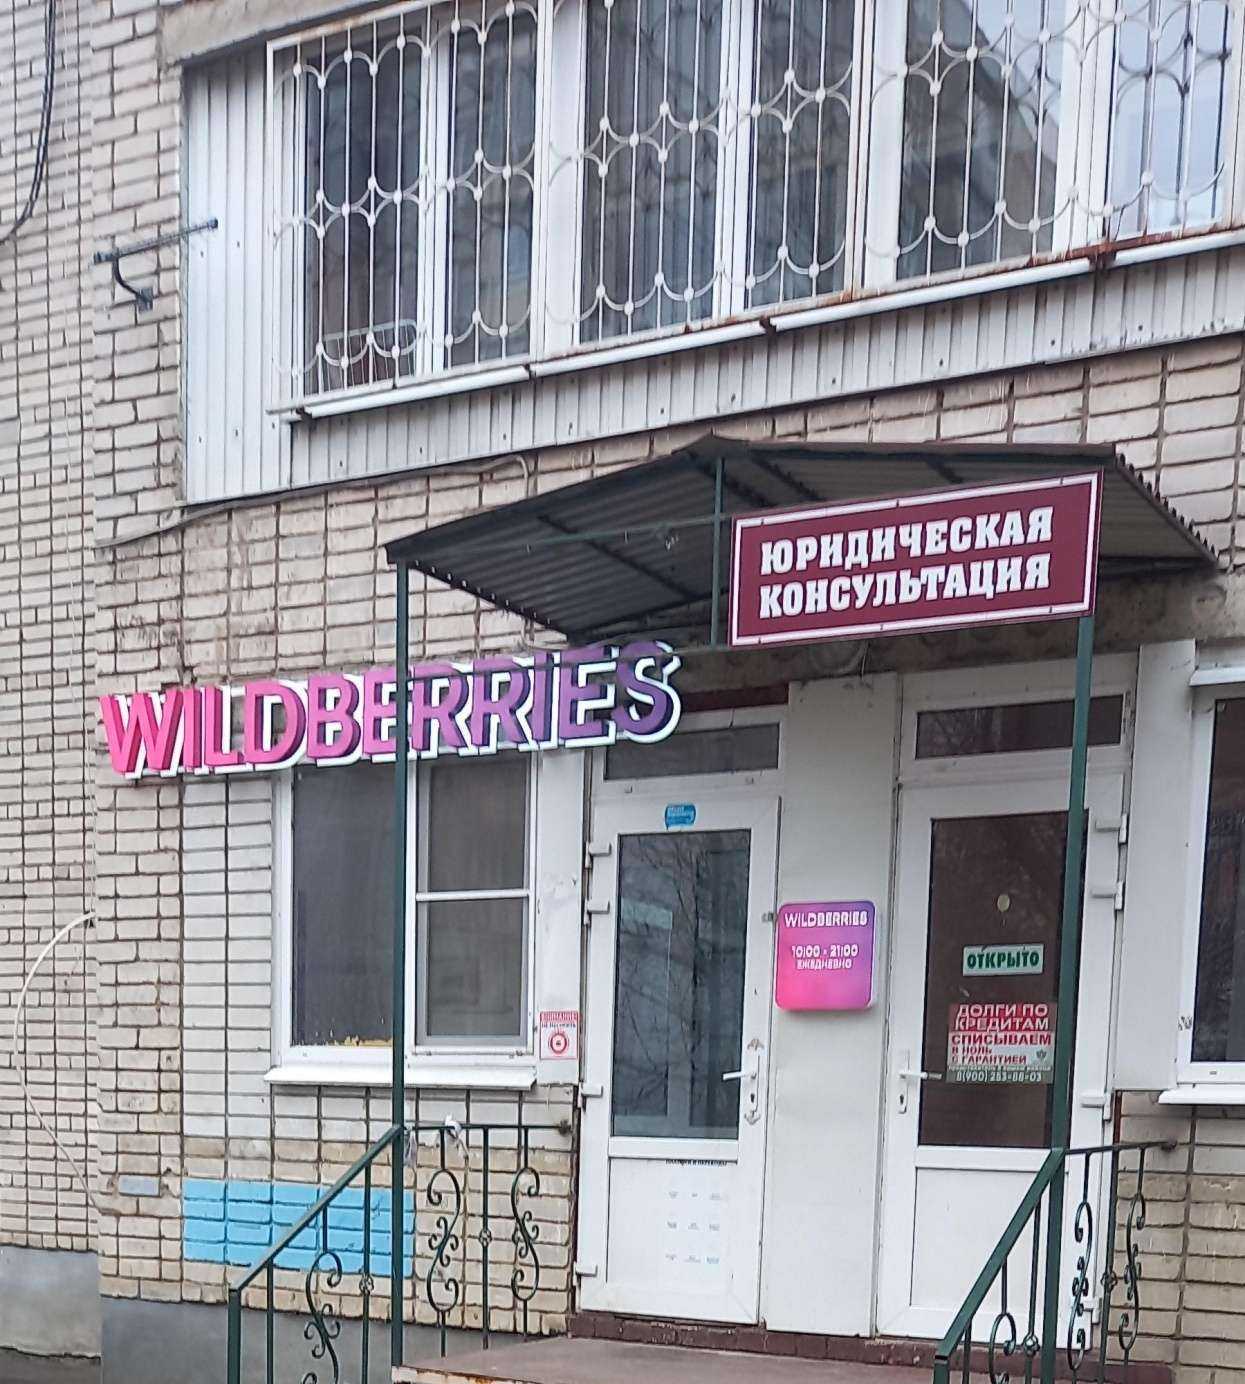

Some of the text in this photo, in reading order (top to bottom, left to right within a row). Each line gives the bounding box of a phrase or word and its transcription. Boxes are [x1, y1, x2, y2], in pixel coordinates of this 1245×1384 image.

[760, 506, 1055, 576] ЮРИДИЧЕСКАЯ
[759, 553, 1052, 619] КОНСУЛЬТАЦИЯ
[99, 641, 682, 780] WILDBERRIES
[784, 911, 868, 928] WILDBERRIES
[791, 945, 821, 959] 10:00
[829, 944, 859, 958] 21:00
[966, 951, 1040, 970] ОТКРЫТО
[958, 1003, 1049, 1018] ДОЛГИ ПО
[955, 1017, 1049, 1032] КРЕДИТАМ
[951, 1034, 1051, 1046] СПИСЫВАЕМ
